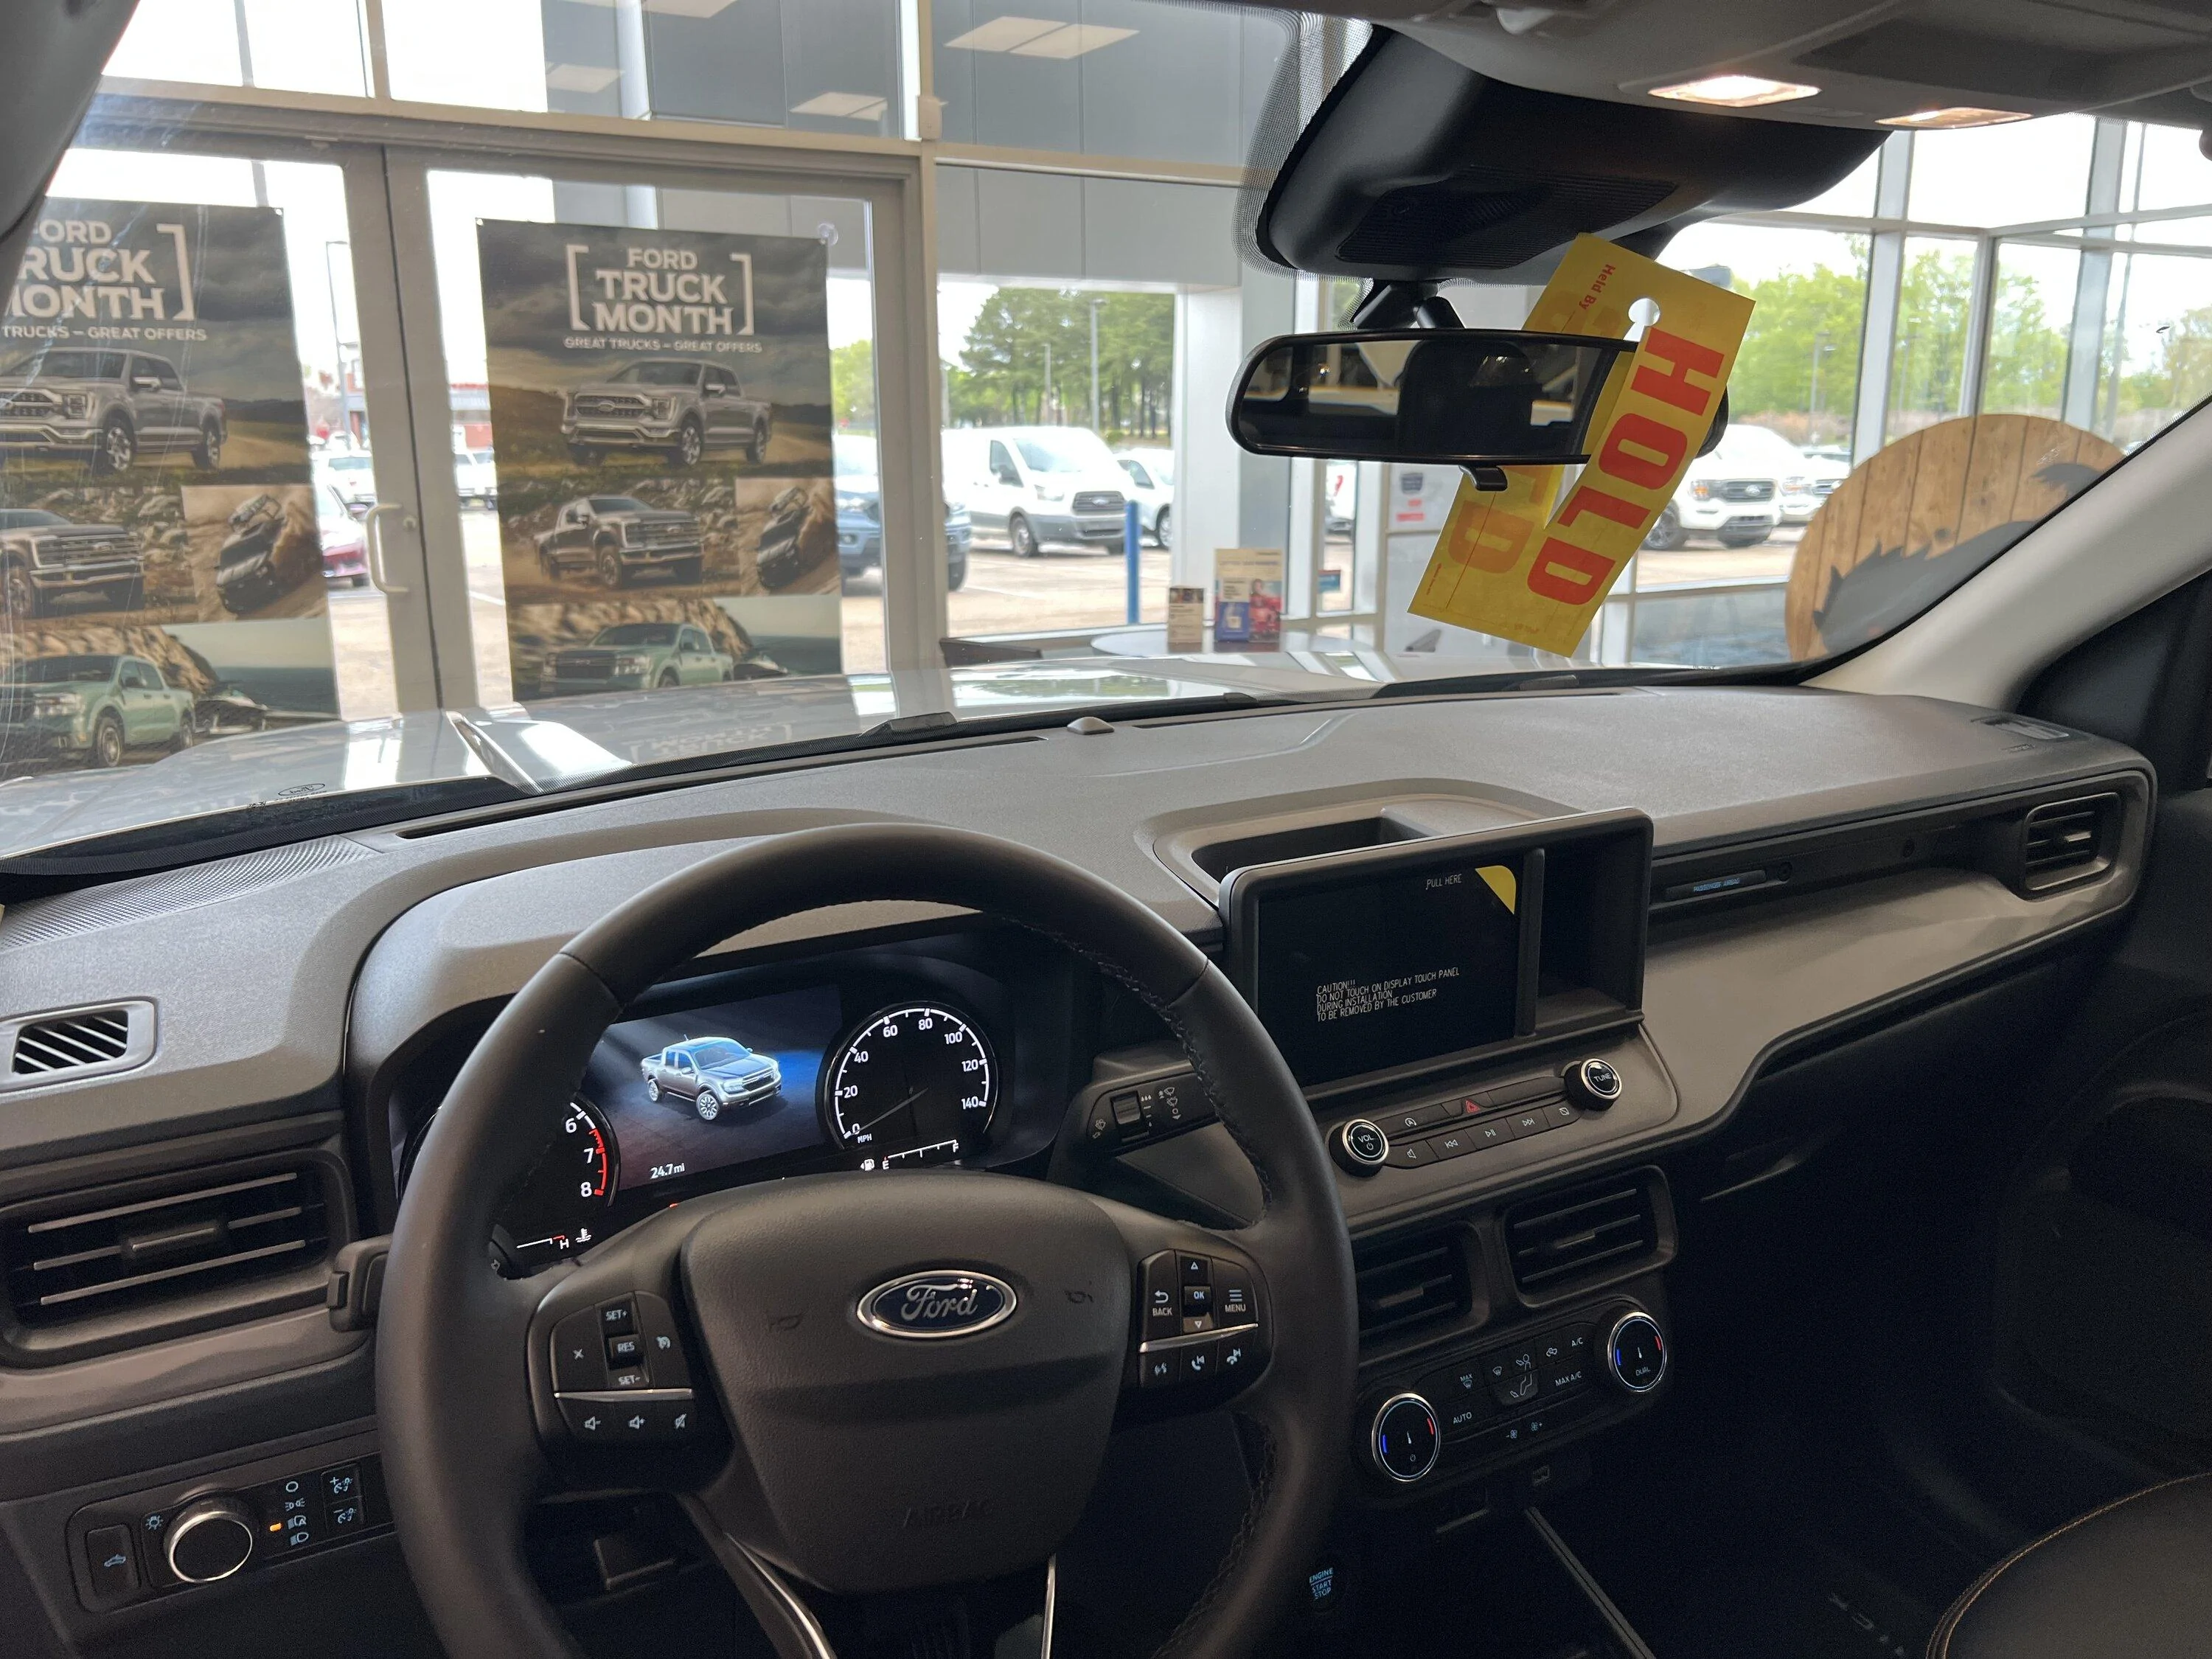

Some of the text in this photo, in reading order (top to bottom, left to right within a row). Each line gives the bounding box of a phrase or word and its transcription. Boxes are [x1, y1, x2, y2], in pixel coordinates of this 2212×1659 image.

[35, 218, 112, 244] ORD
[18, 246, 157, 285] RUCK
[627, 248, 698, 270] FORD
[596, 269, 728, 304] TRUCK
[1579, 264, 1615, 310] Held By
[592, 302, 734, 335] MONTH
[2, 325, 70, 339] TRUCKS
[87, 326, 143, 340] GREAT
[144, 327, 207, 341] OFFERS
[564, 336, 605, 349] GREAT
[609, 338, 661, 351] TRUCKS
[673, 340, 713, 352] GREAT
[716, 341, 762, 353] OFFERS
[1527, 327, 1725, 605] HOLD
[1426, 873, 1462, 889] PULL HERE
[1316, 967, 1460, 1004] DO NOT TOUCH ON DISPLAY TOUCH PANEL
[1317, 979, 1356, 995] CAUTION!!!
[1316, 990, 1393, 1014] DURING INSTALLATION
[1317, 988, 1437, 1022] TO BE REMOVED BY THE CUSTOMER
[883, 1024, 898, 1038] 60
[918, 1018, 933, 1031] 80
[945, 1032, 963, 1045] 100
[854, 1051, 869, 1063] 40
[961, 1059, 979, 1072] 120
[1593, 1071, 1613, 1084] TUNE
[844, 1085, 858, 1099] 20
[961, 1096, 979, 1110] 140
[565, 1117, 577, 1133] 6
[852, 1123, 860, 1135] 0
[857, 1133, 872, 1144] MPH
[1357, 1133, 1374, 1144] VOL
[953, 1143, 959, 1152] F
[583, 1147, 594, 1164] 7
[882, 1160, 889, 1170] E
[580, 1181, 593, 1197] 8
[560, 1239, 569, 1250] H
[1193, 1290, 1205, 1300] OK
[900, 1283, 978, 1322] Ford
[1225, 1304, 1246, 1313] MENU
[606, 1309, 627, 1321] SET+
[1152, 1307, 1172, 1317] BACK
[617, 1341, 635, 1354] RES
[1571, 1337, 1584, 1347] A/C
[1460, 1372, 1473, 1382] MAX
[1554, 1370, 1582, 1387] MAX A/C
[1635, 1366, 1651, 1377] DUAL
[1453, 1411, 1472, 1425] AUTO
[1309, 1567, 1333, 1584] ENGINE
[1312, 1579, 1332, 1593] START
[1314, 1587, 1332, 1600] STOP
